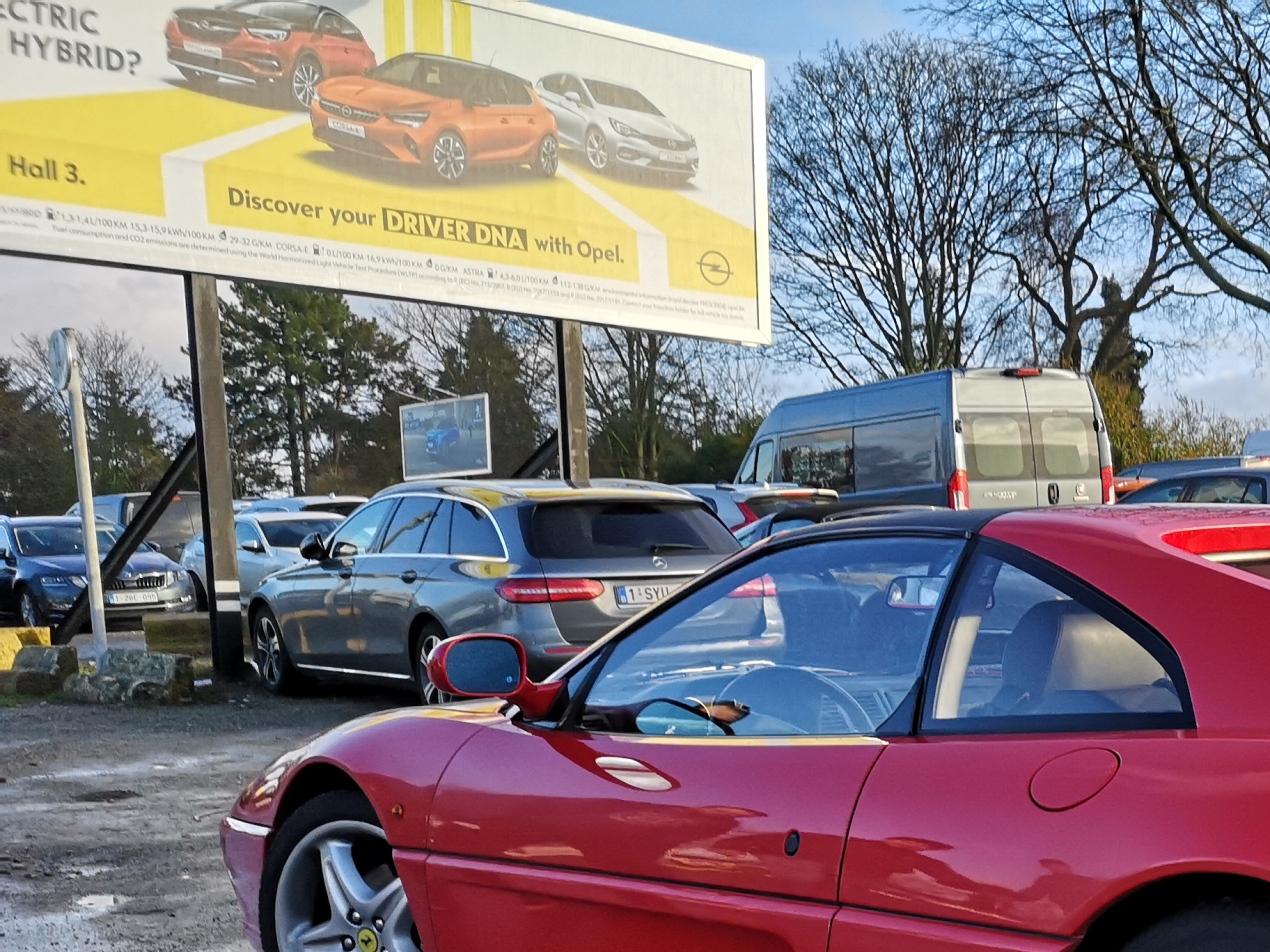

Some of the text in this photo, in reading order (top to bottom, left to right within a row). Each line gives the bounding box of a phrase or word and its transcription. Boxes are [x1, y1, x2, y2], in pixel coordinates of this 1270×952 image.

[9, 28, 142, 76] HYBRID?
[8, 153, 86, 185] Hall 3.
[202, 232, 215, 241] KM
[228, 186, 624, 264] Discover your DRIVER DNA with Opel.
